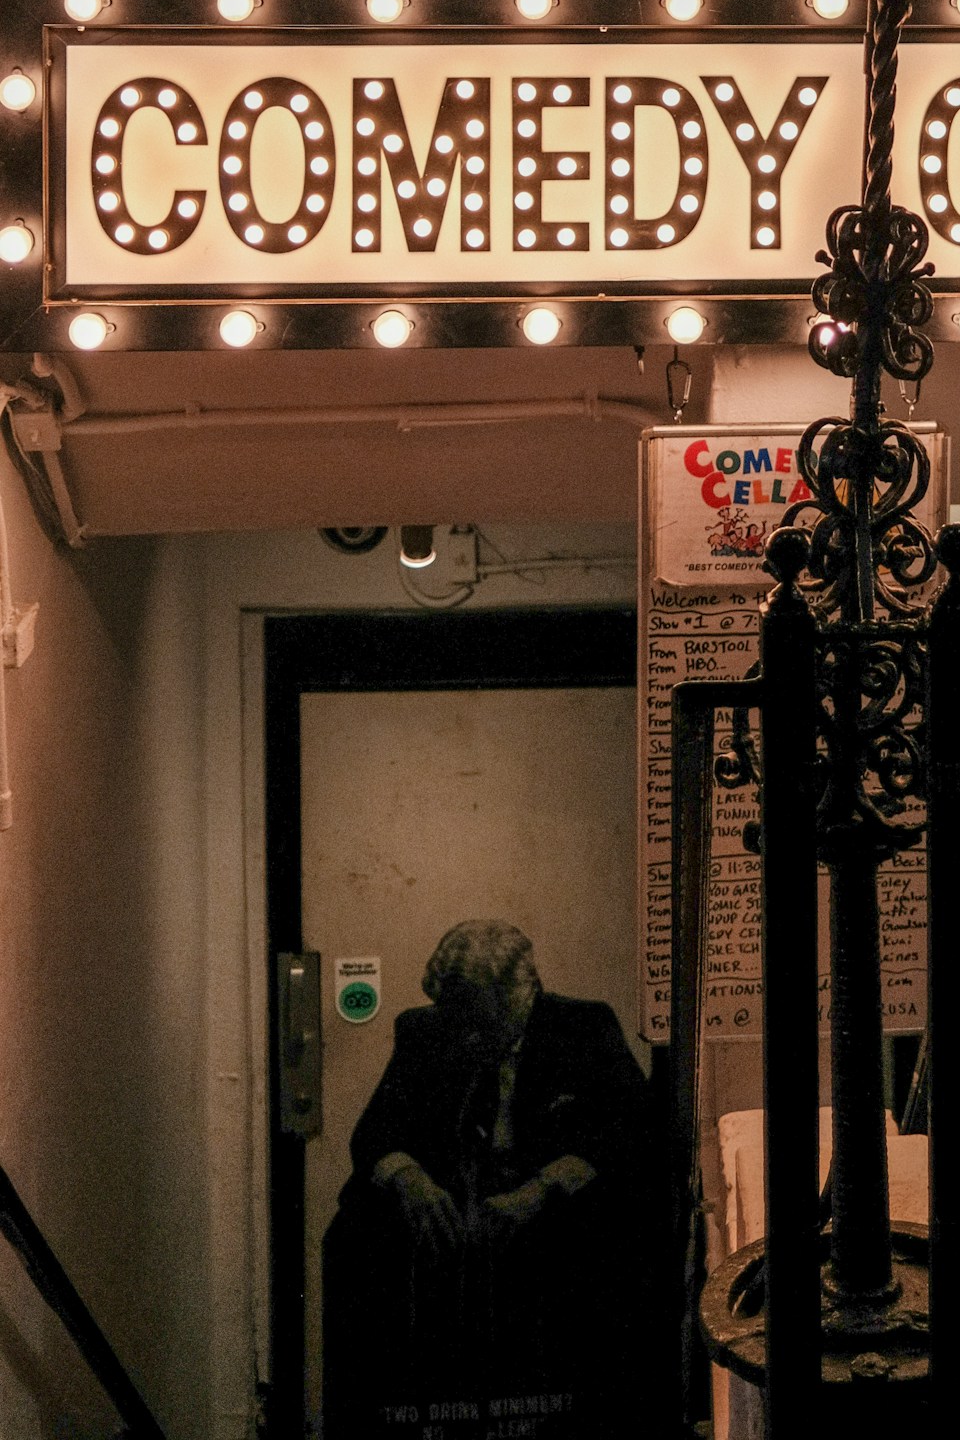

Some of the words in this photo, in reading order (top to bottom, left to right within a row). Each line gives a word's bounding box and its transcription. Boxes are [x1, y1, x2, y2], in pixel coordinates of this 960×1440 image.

[91, 75, 829, 254] COMEDY
[683, 440, 819, 478] COMED
[701, 472, 814, 509] CELLA
[715, 562, 754, 571] COMEDY
[650, 588, 720, 608] Welcome
[731, 592, 747, 605] to
[650, 616, 678, 631] Show
[743, 614, 759, 628] 7:
[650, 641, 677, 660] From
[684, 640, 752, 655] BARSTOOL
[648, 662, 676, 675] From
[716, 793, 746, 805] LATE
[732, 883, 761, 896] GAR
